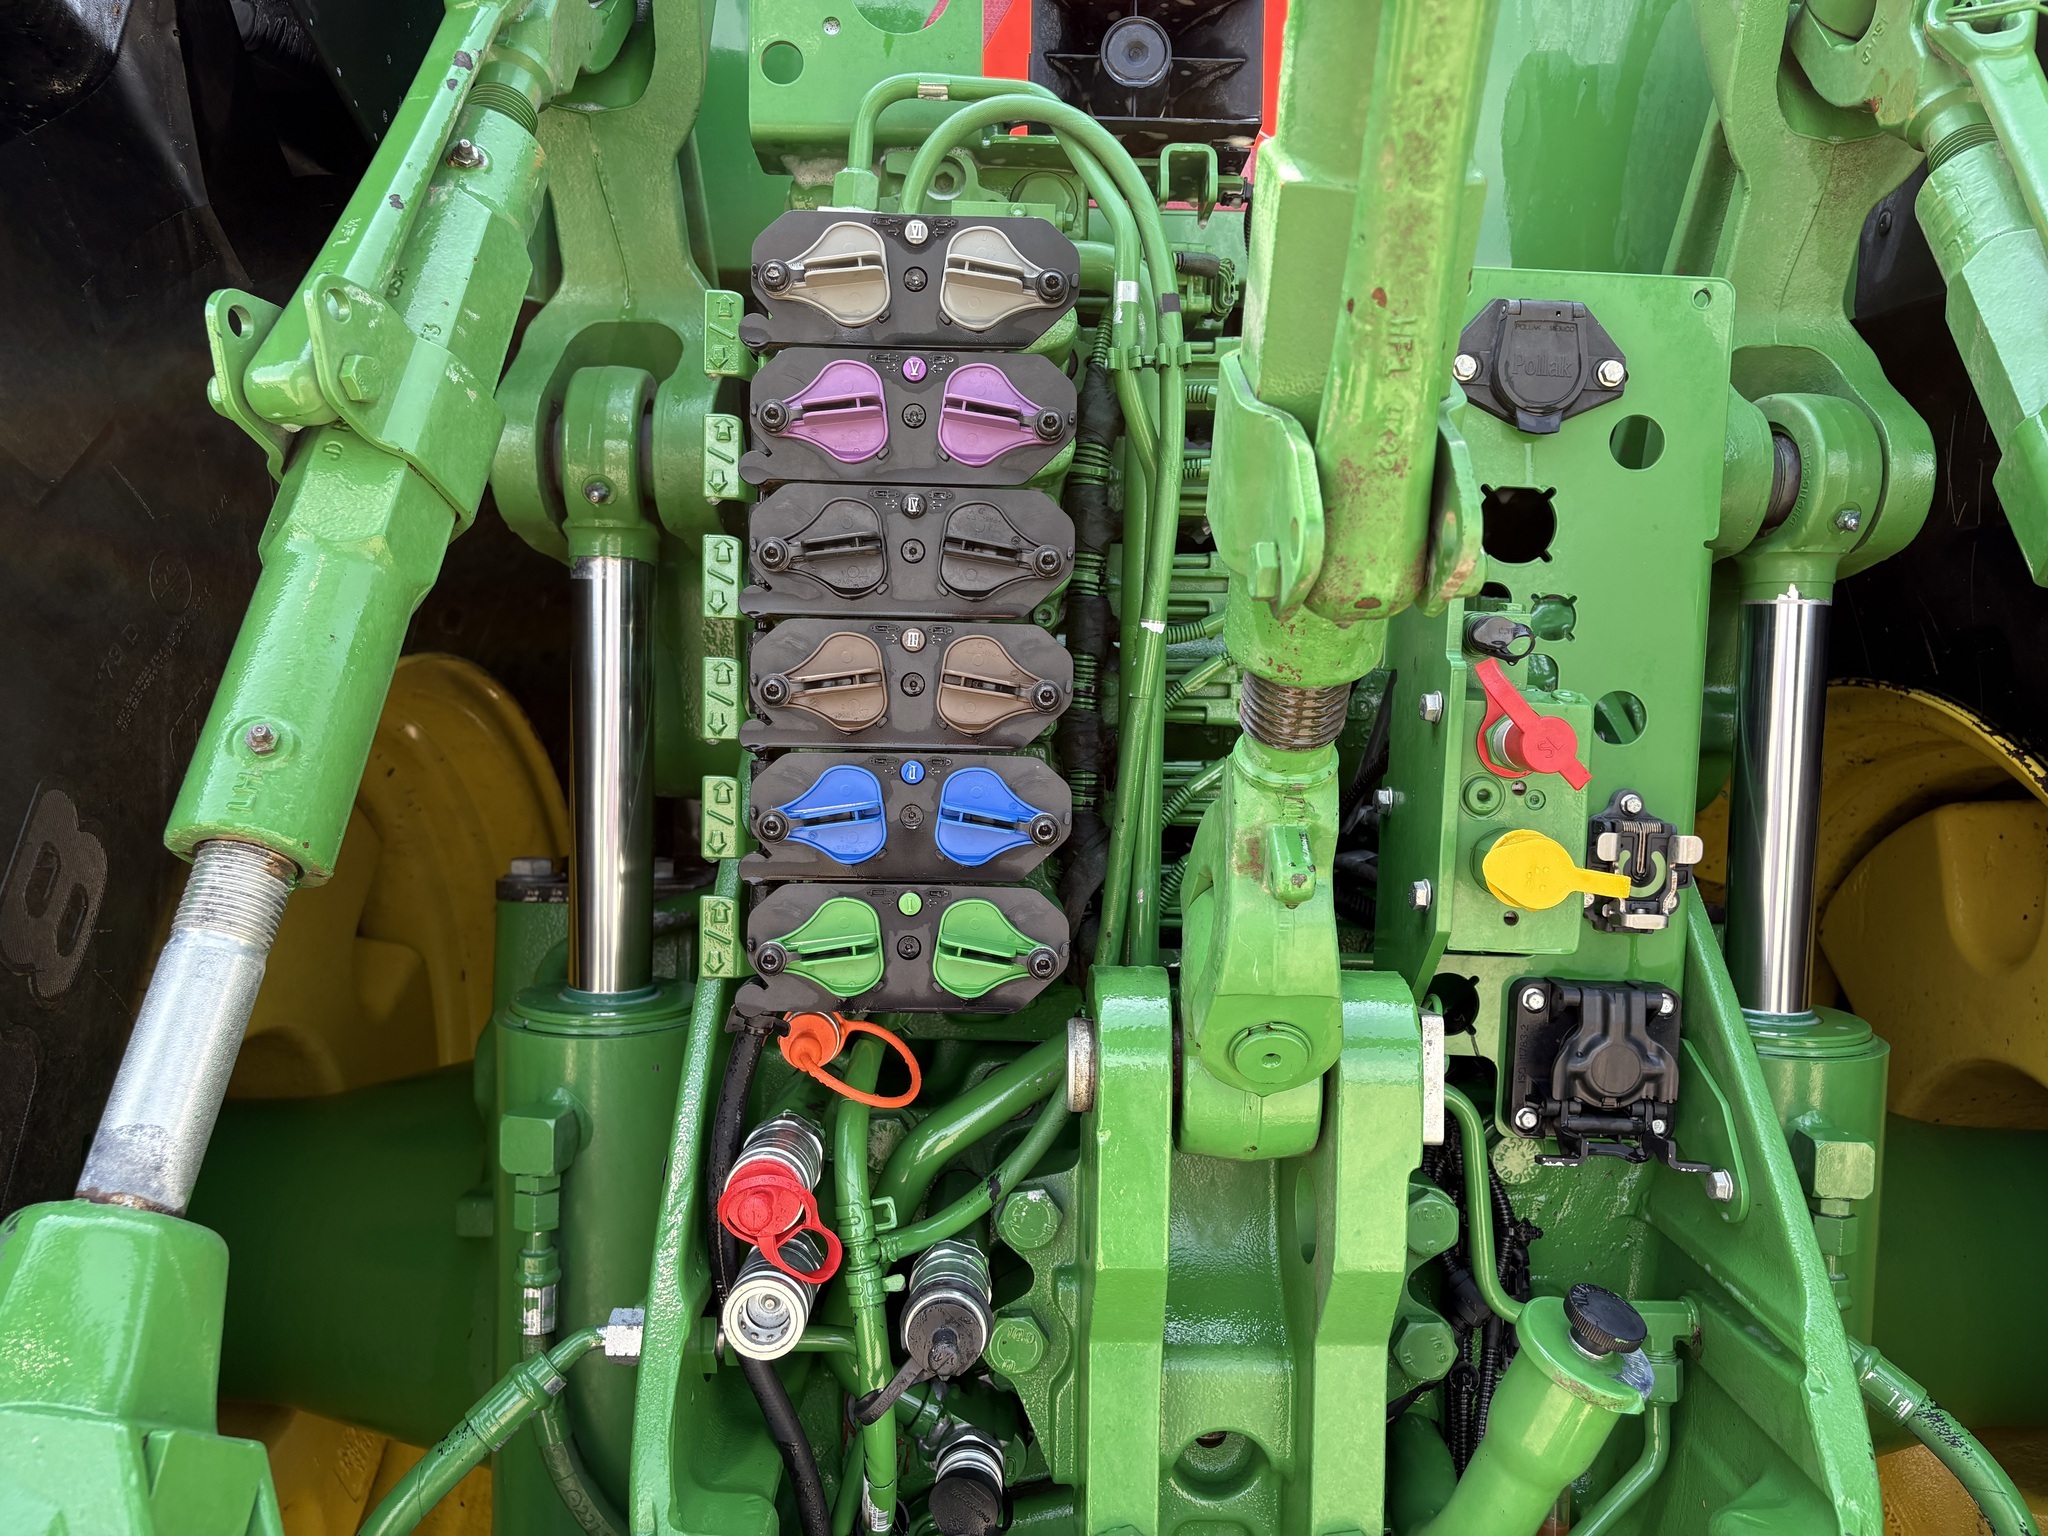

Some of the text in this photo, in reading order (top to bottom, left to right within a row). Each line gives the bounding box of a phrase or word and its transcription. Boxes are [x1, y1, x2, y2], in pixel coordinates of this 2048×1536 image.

[909, 223, 922, 238] VI
[1514, 323, 1575, 333] POLLAK MEXICO
[908, 359, 920, 375] V
[1512, 353, 1573, 378] Pollak
[1536, 734, 1565, 760] SL
[1518, 1024, 1529, 1084] ISO 11783-2
